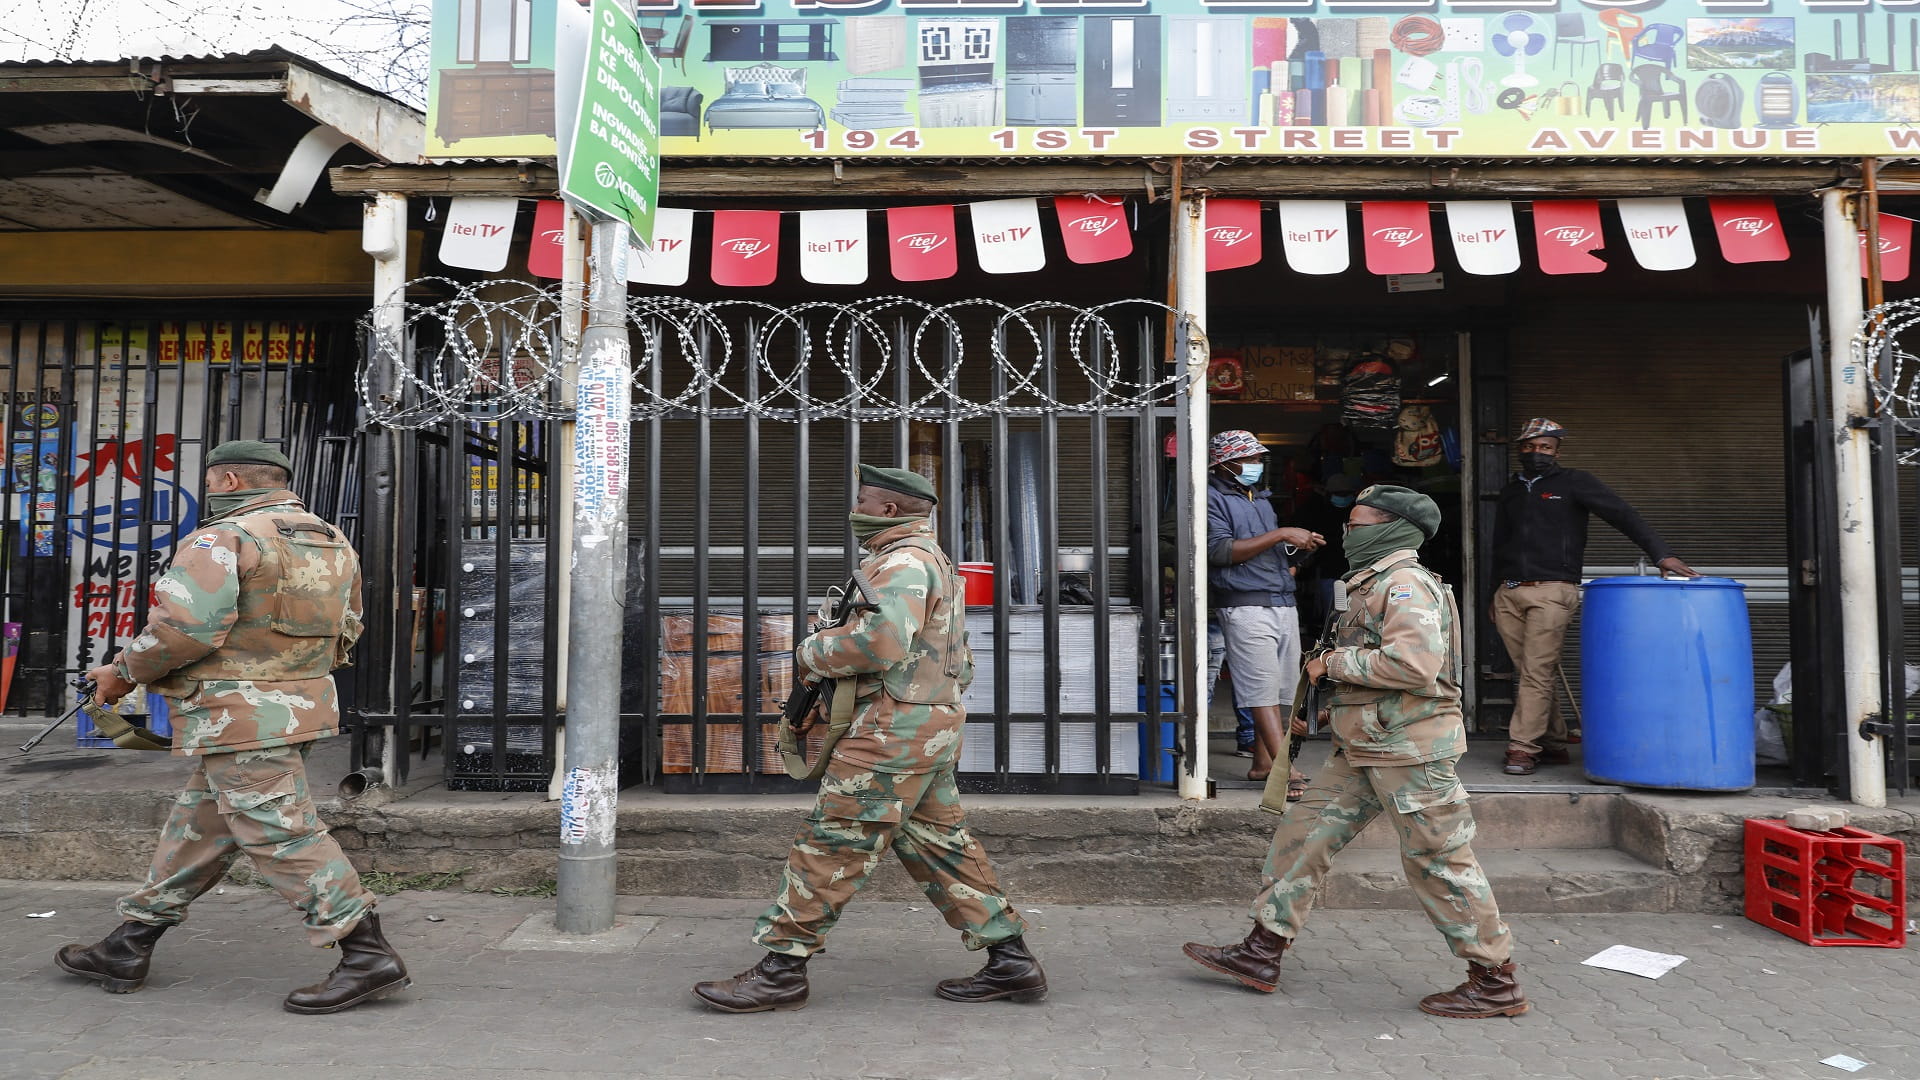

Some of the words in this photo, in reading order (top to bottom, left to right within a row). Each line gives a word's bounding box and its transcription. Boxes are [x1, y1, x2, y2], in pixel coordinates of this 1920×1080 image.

[602, 9, 615, 28] O
[599, 47, 617, 74] KE
[589, 119, 608, 143] BA
[804, 130, 920, 149] 194
[993, 130, 1115, 149] 1ST
[1188, 130, 1459, 149] STREET
[1532, 130, 1818, 149] AVENUE
[452, 223, 477, 237] itel
[479, 223, 506, 238] TV
[981, 231, 1006, 244] itel
[1007, 226, 1033, 242] TV
[1288, 230, 1311, 243] itel
[1313, 228, 1340, 243] TV
[1457, 231, 1480, 244] itel
[1481, 228, 1507, 244] TV
[1630, 227, 1653, 240] itel
[1654, 224, 1680, 240] TV
[657, 238, 683, 252] TV
[807, 240, 831, 253] itel
[834, 238, 859, 253] TV
[220, 340, 231, 361] &
[605, 421, 620, 443] 065
[606, 445, 620, 466] 558
